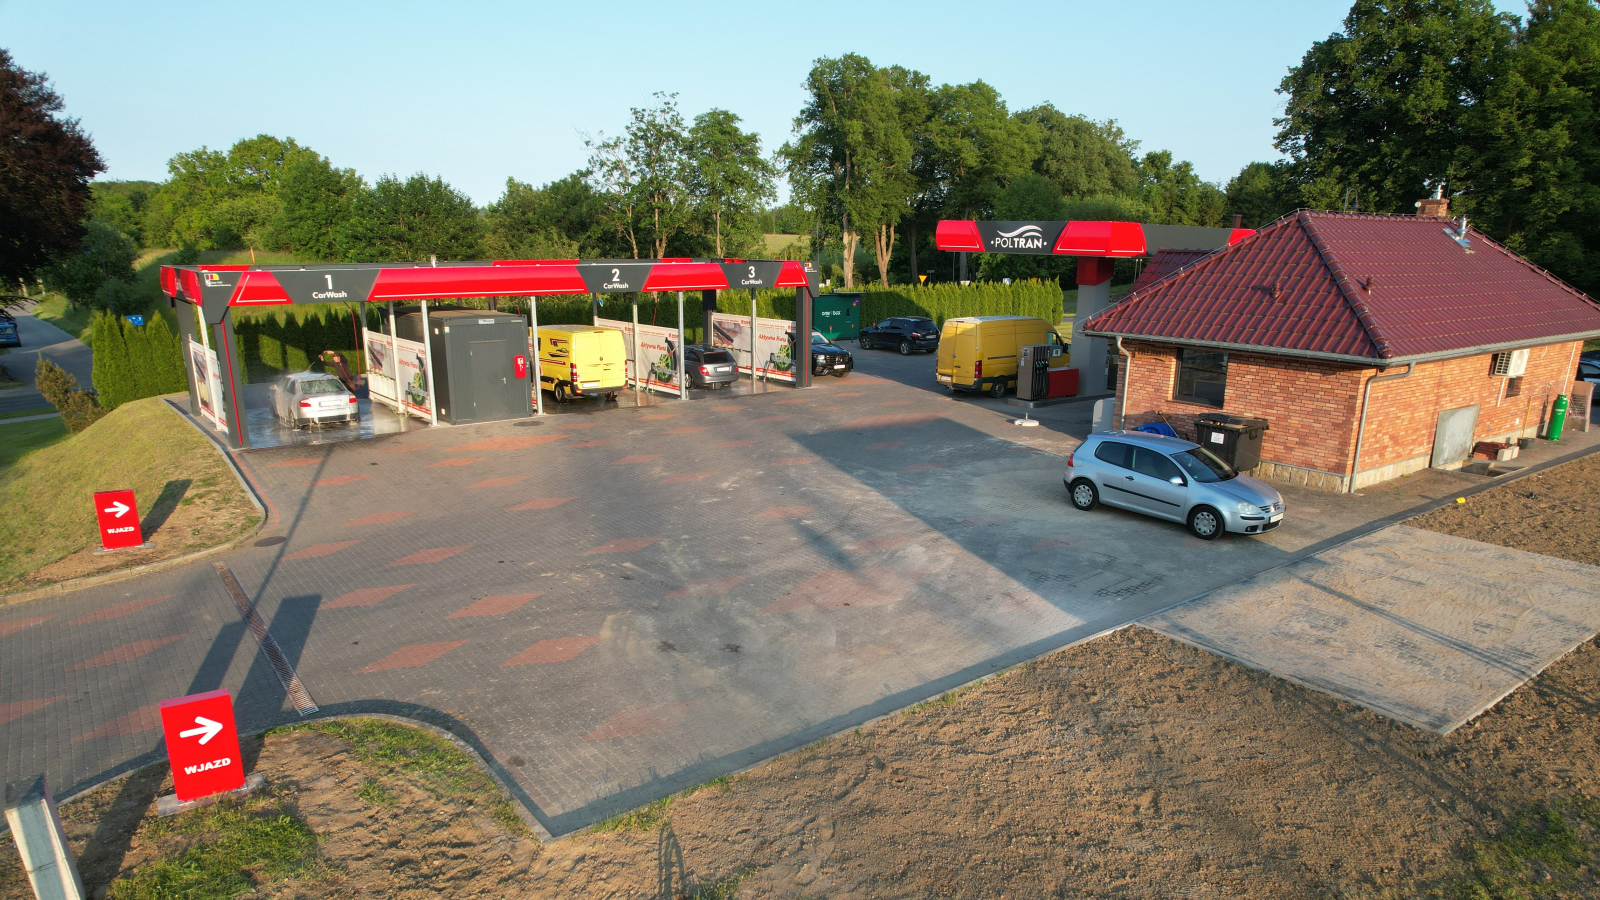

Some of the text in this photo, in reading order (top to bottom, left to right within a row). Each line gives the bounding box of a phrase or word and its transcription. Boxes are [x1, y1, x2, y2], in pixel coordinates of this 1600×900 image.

[994, 237, 1043, 249] POLTRAN
[611, 268, 620, 282] 2
[748, 265, 756, 279] 3
[324, 274, 333, 290] 1
[603, 282, 629, 290] CarWash
[312, 290, 348, 299] CarWash
[107, 526, 135, 534] WJAZD
[184, 757, 231, 775] WJAZD
